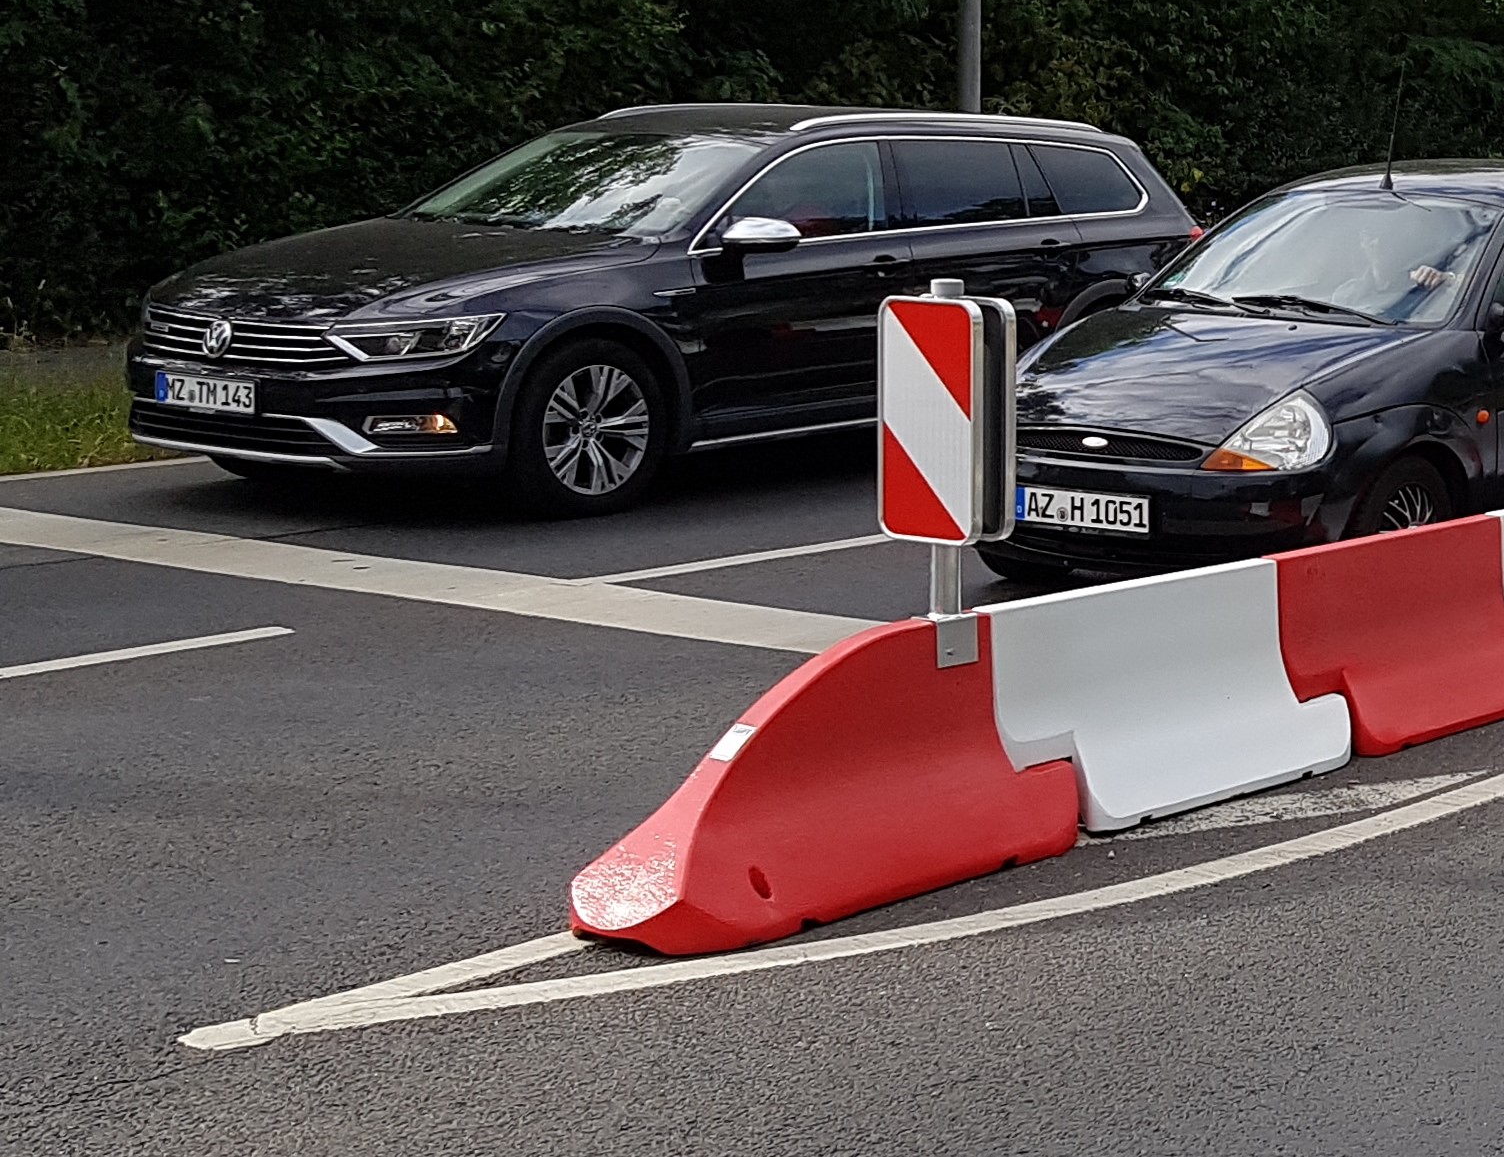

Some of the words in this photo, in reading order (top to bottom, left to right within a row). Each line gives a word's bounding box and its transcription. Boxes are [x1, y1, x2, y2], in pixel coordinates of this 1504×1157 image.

[166, 378, 185, 401] MZ
[196, 381, 217, 405] TM
[221, 384, 252, 408] 143
[1027, 492, 1055, 519] AZ
[1070, 496, 1084, 522] H
[1090, 498, 1147, 528] 1051
